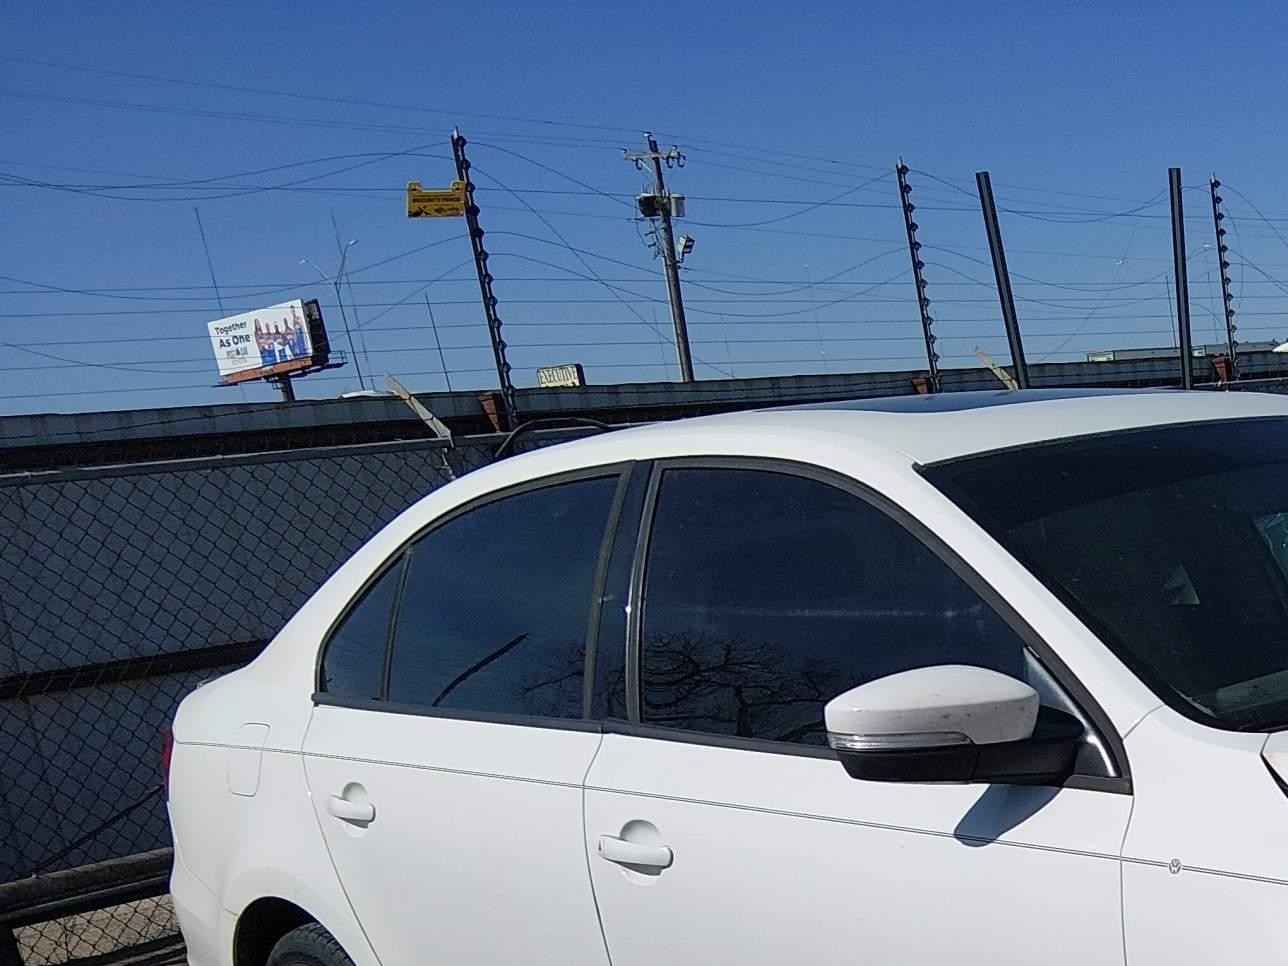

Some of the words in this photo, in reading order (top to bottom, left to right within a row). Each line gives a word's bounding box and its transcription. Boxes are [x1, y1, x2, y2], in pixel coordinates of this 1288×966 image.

[214, 321, 247, 335] Together
[219, 338, 231, 349] As
[232, 334, 251, 345] One
[539, 366, 578, 384] EXECUTIVE
